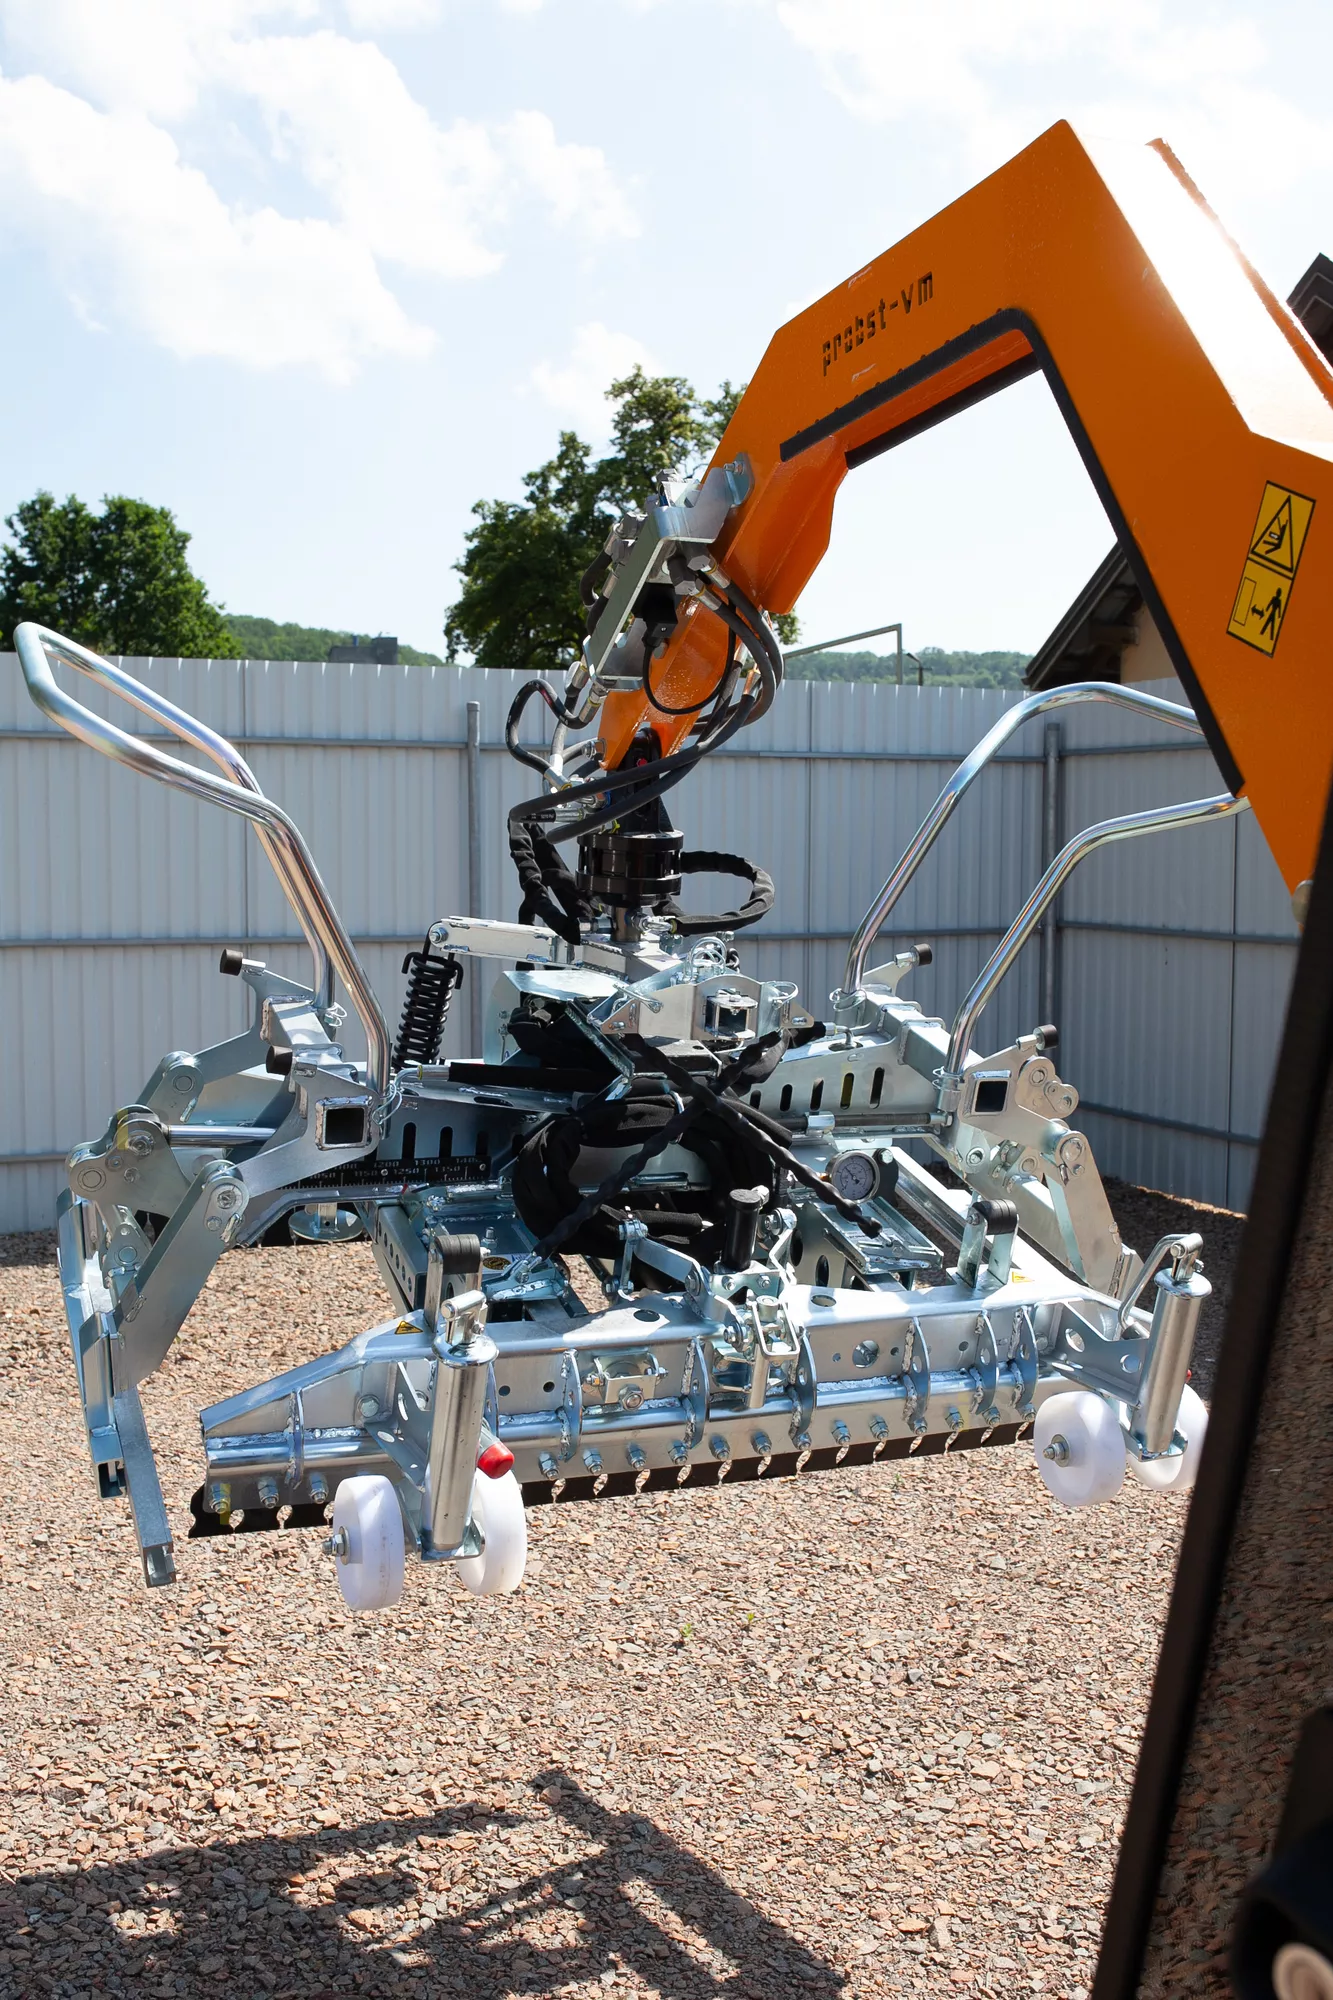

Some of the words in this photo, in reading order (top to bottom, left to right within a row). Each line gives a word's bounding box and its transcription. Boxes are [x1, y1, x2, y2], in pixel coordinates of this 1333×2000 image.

[822, 271, 934, 377] probst-vm
[373, 1160, 399, 1169] 1200
[414, 1158, 441, 1166] 1300
[354, 1169, 378, 1177] 1150
[394, 1167, 420, 1175] 1250
[434, 1165, 461, 1173] 1350
